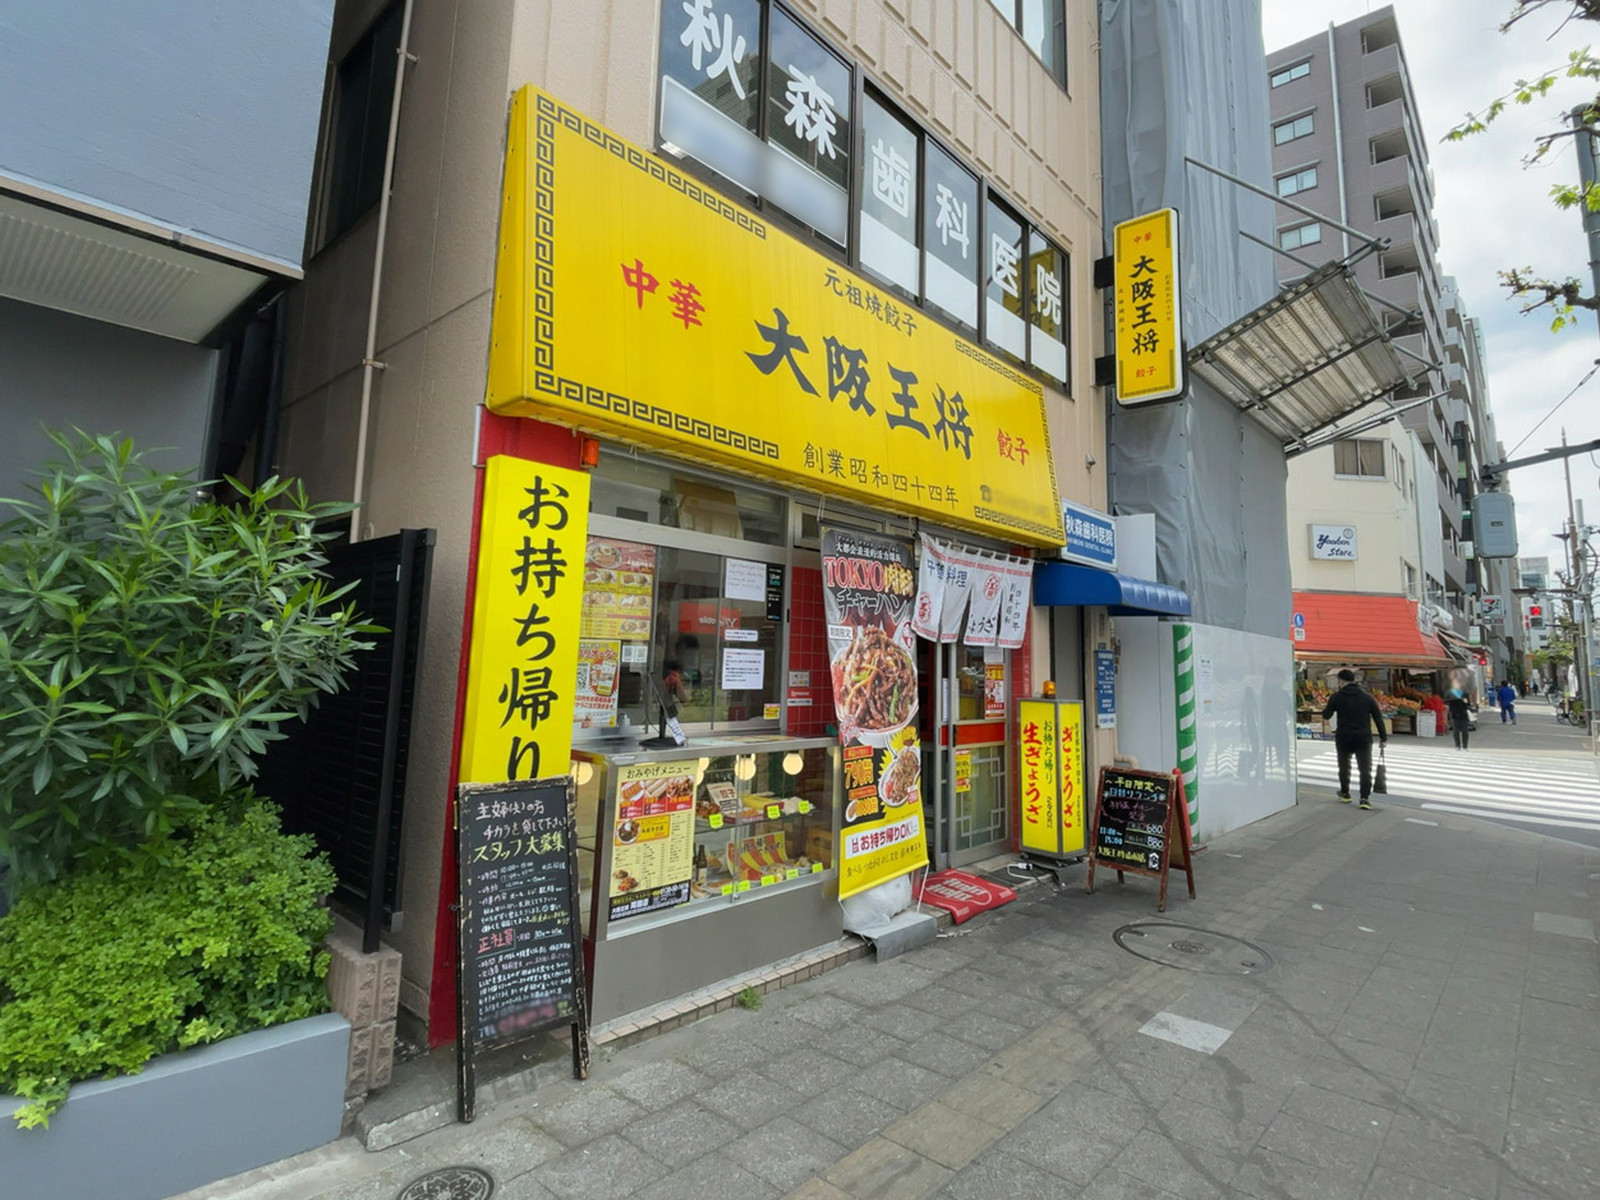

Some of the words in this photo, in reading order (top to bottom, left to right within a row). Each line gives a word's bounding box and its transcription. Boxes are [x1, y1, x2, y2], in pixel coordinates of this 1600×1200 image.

[680, 0, 1061, 326] 秋森歯科医院
[621, 258, 706, 329] 中華
[824, 268, 918, 338] 元祖焼餃子
[1129, 255, 1160, 356] 大阪王将
[745, 307, 975, 460] 大阪王将
[803, 442, 958, 510] 創業昭和四十四年
[997, 428, 1030, 466] 餃子
[1066, 515, 1113, 547] 秋森歯科医院
[1327, 548, 1354, 557] Store
[498, 475, 569, 781] お持ち帰り
[837, 588, 907, 626] チャーハン
[626, 767, 690, 779] おみやげメニュー
[1023, 721, 1043, 825] 生ぎょうざ
[1062, 726, 1075, 828] ぎょうざ
[473, 830, 566, 863] スタッフ大募集
[478, 928, 514, 954] 正社員
